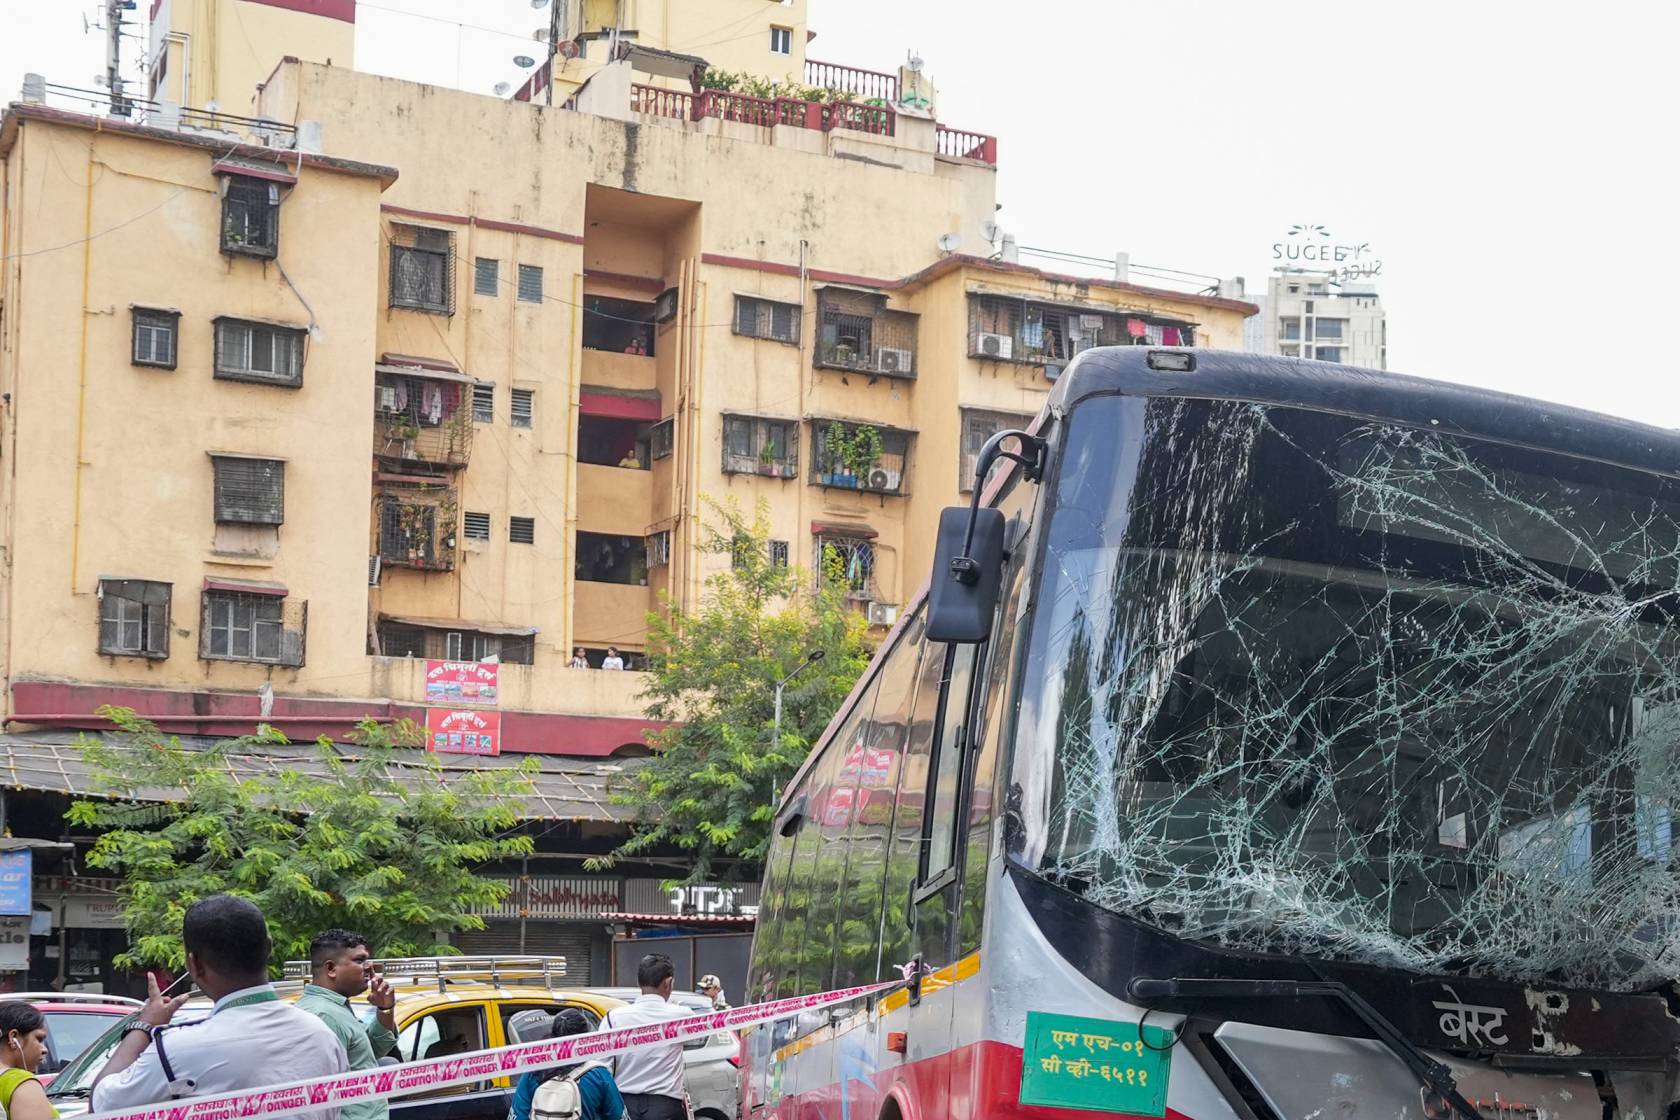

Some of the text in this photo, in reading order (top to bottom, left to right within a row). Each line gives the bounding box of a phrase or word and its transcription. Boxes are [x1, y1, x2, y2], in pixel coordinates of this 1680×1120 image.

[1273, 243, 1344, 261] SUGEE
[1432, 984, 1510, 1046] बेस्ट
[1051, 1029, 1078, 1050] एम
[577, 1042, 611, 1057] CAUTION
[526, 1053, 554, 1066] WORK
[1041, 1054, 1062, 1074] सी
[463, 1063, 498, 1078] DANGER
[399, 1073, 439, 1089] CAUTION
[340, 1085, 370, 1099] WORK
[267, 1097, 307, 1114] DANGER
